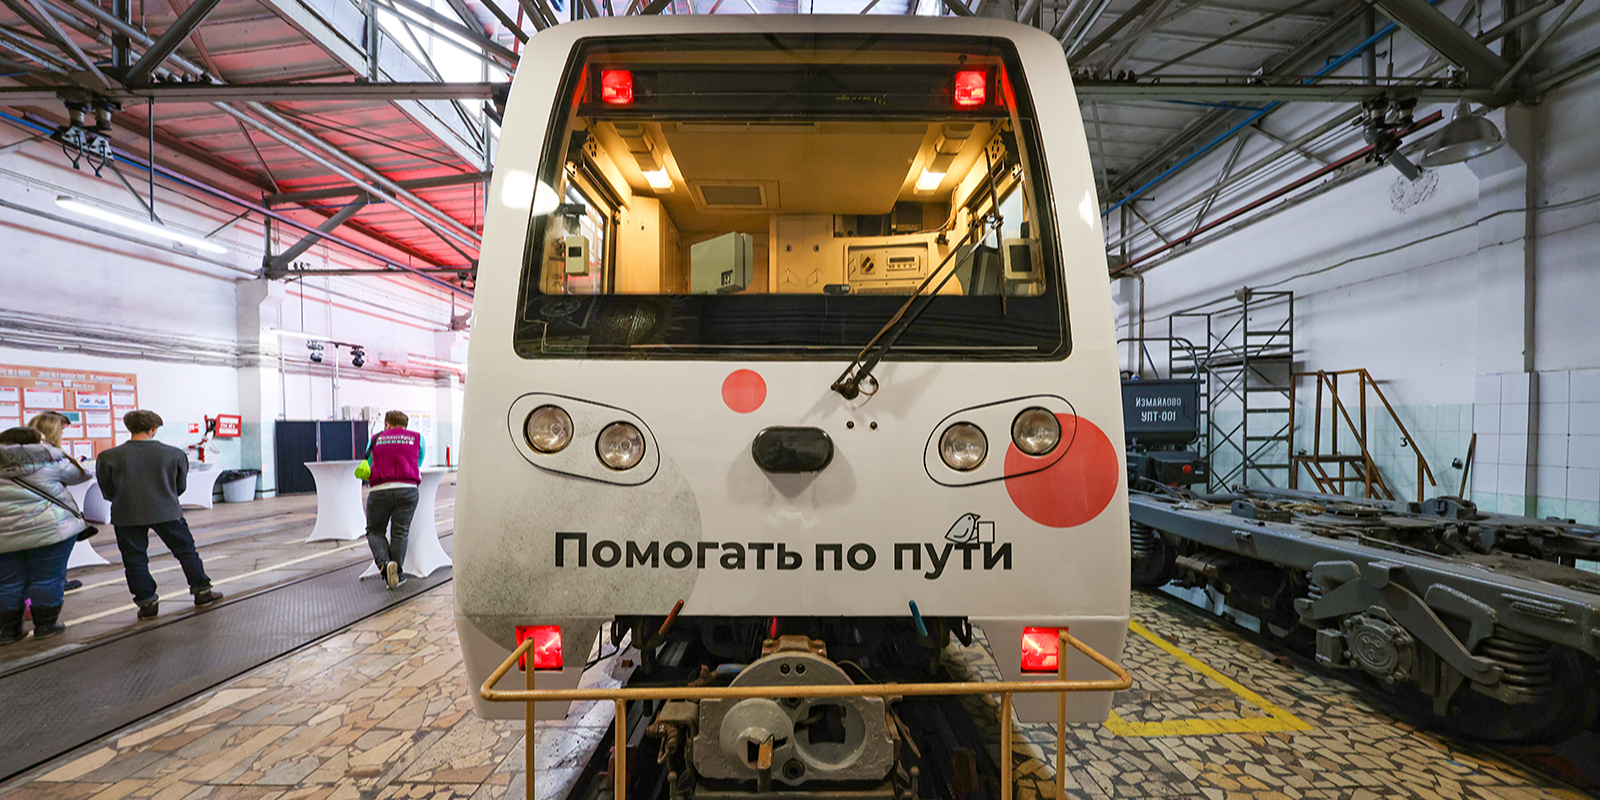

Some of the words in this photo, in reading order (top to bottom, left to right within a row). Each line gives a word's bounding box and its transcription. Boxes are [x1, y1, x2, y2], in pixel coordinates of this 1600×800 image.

[1135, 396, 1182, 408] ИЗМАЙЛОВО
[1141, 411, 1177, 422] УПТ-001
[1400, 436, 1408, 448] 3
[555, 532, 803, 571] Помогать
[815, 542, 877, 571] по
[893, 541, 1013, 580] пути
